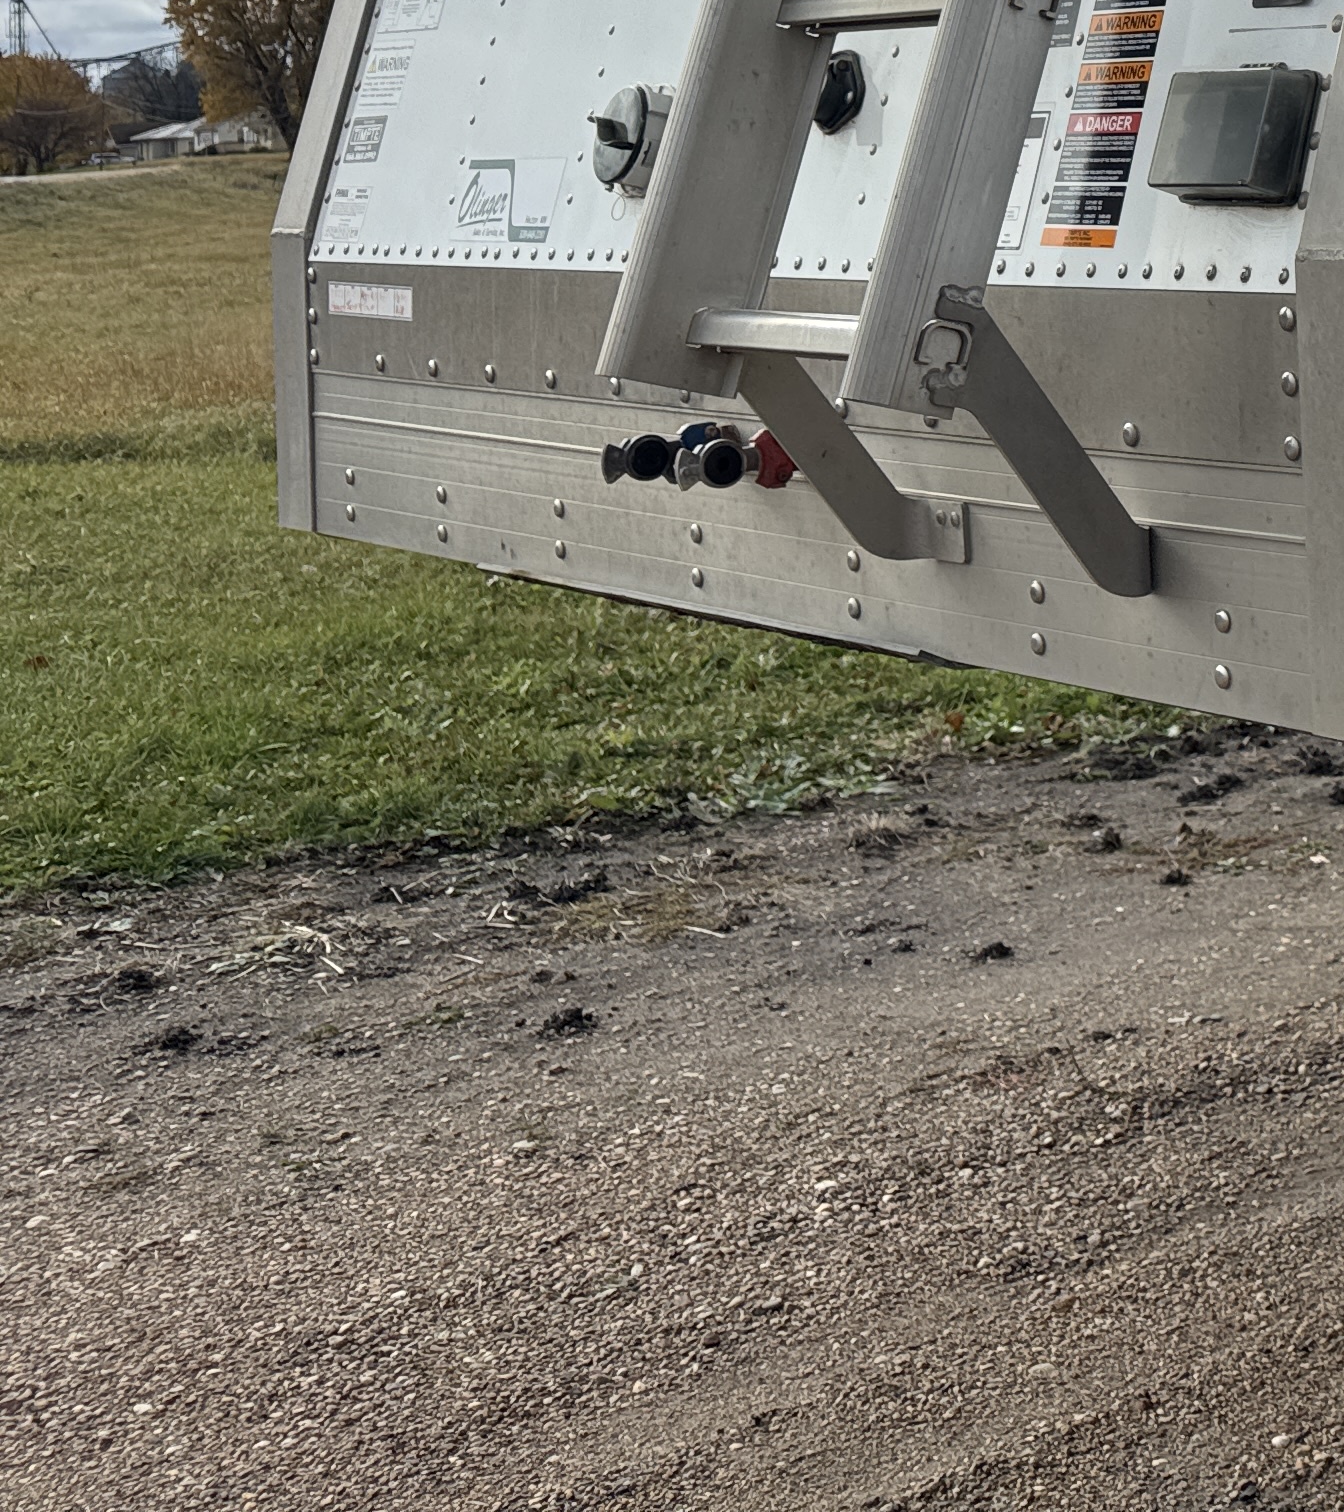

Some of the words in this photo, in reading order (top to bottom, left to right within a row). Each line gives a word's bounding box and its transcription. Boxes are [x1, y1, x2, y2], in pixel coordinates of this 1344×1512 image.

[1105, 13, 1157, 31] WARNING
[1095, 64, 1146, 80] WARNING
[1085, 115, 1133, 132] DANGER
[353, 126, 381, 143] TIMPTE
[457, 170, 508, 226] Olinger
